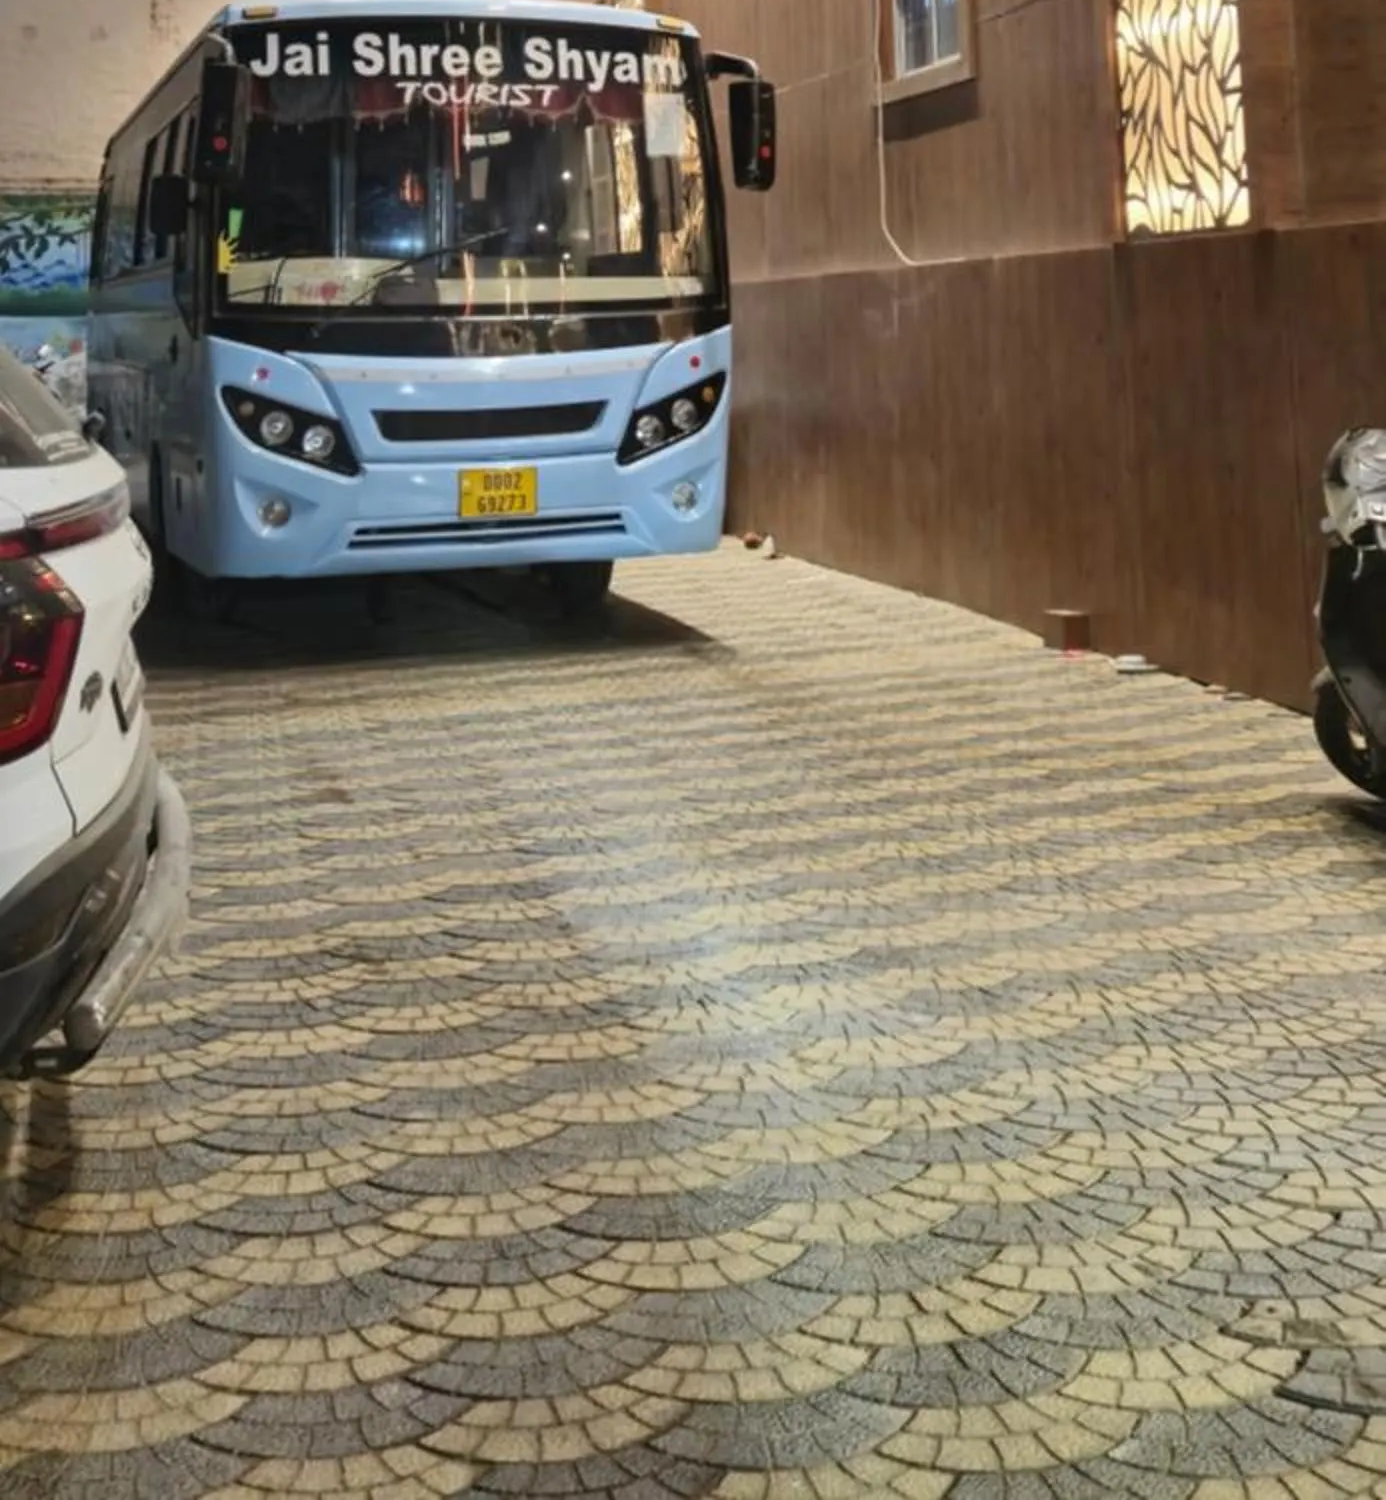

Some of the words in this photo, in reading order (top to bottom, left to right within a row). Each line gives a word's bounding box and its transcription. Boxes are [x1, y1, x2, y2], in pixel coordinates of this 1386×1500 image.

[249, 32, 331, 77] Jai
[352, 32, 503, 77] Shree
[523, 36, 685, 93] Shyam
[395, 81, 560, 107] TOURIST
